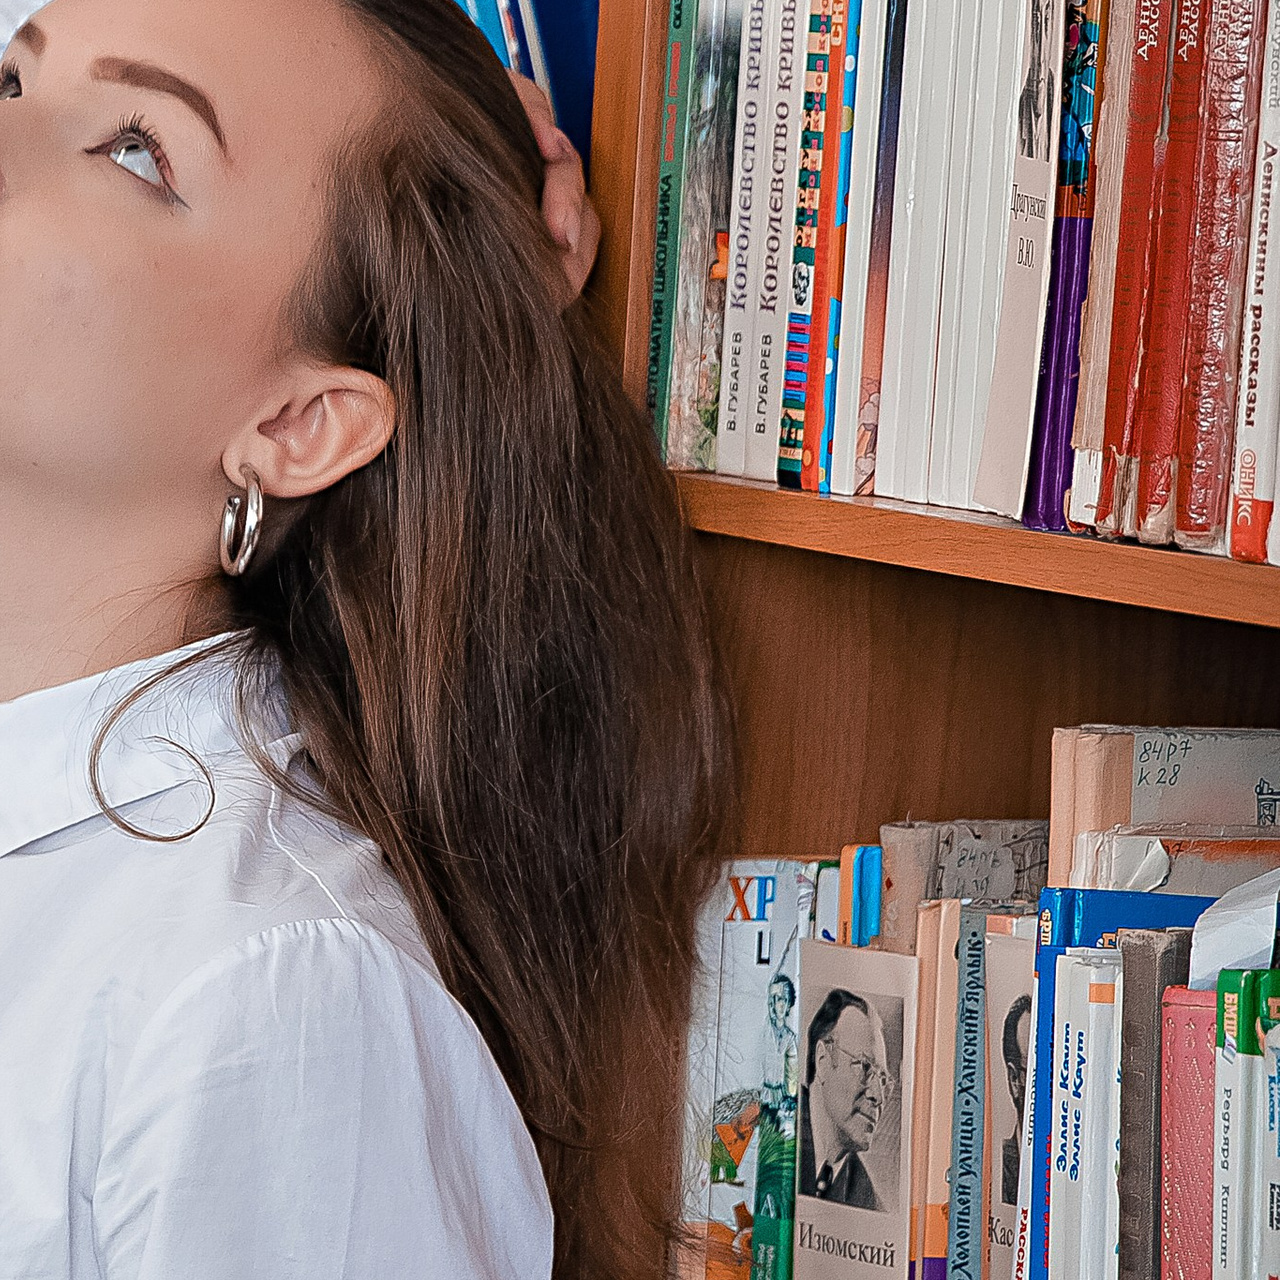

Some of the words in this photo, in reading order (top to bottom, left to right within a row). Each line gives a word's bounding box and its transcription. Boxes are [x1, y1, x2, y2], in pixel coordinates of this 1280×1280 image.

[651, 174, 673, 293] ШКОЛЬНИКА
[728, 101, 758, 313] КОРОЛЕВСТВО
[758, 102, 789, 315] КОРОЛЕВСТВО
[1250, 140, 1278, 295] Денискины
[645, 299, 664, 410] ЕСТОМАТИЯ
[1244, 304, 1263, 428] рассказы
[1237, 448, 1257, 527] ОНИКС
[957, 1000, 979, 1104] Ханский
[1059, 1022, 1071, 1090] Каут
[1072, 1030, 1087, 1099] Каут
[956, 1110, 978, 1179] улицы
[1056, 1099, 1069, 1173] Эллис
[1069, 1109, 1081, 1182] Эллис
[1221, 1087, 1232, 1172] Редьярд
[799, 1221, 896, 1268] Изюмский
[990, 1216, 1015, 1247] Кас
[1219, 1184, 1230, 1268] Киплинг
